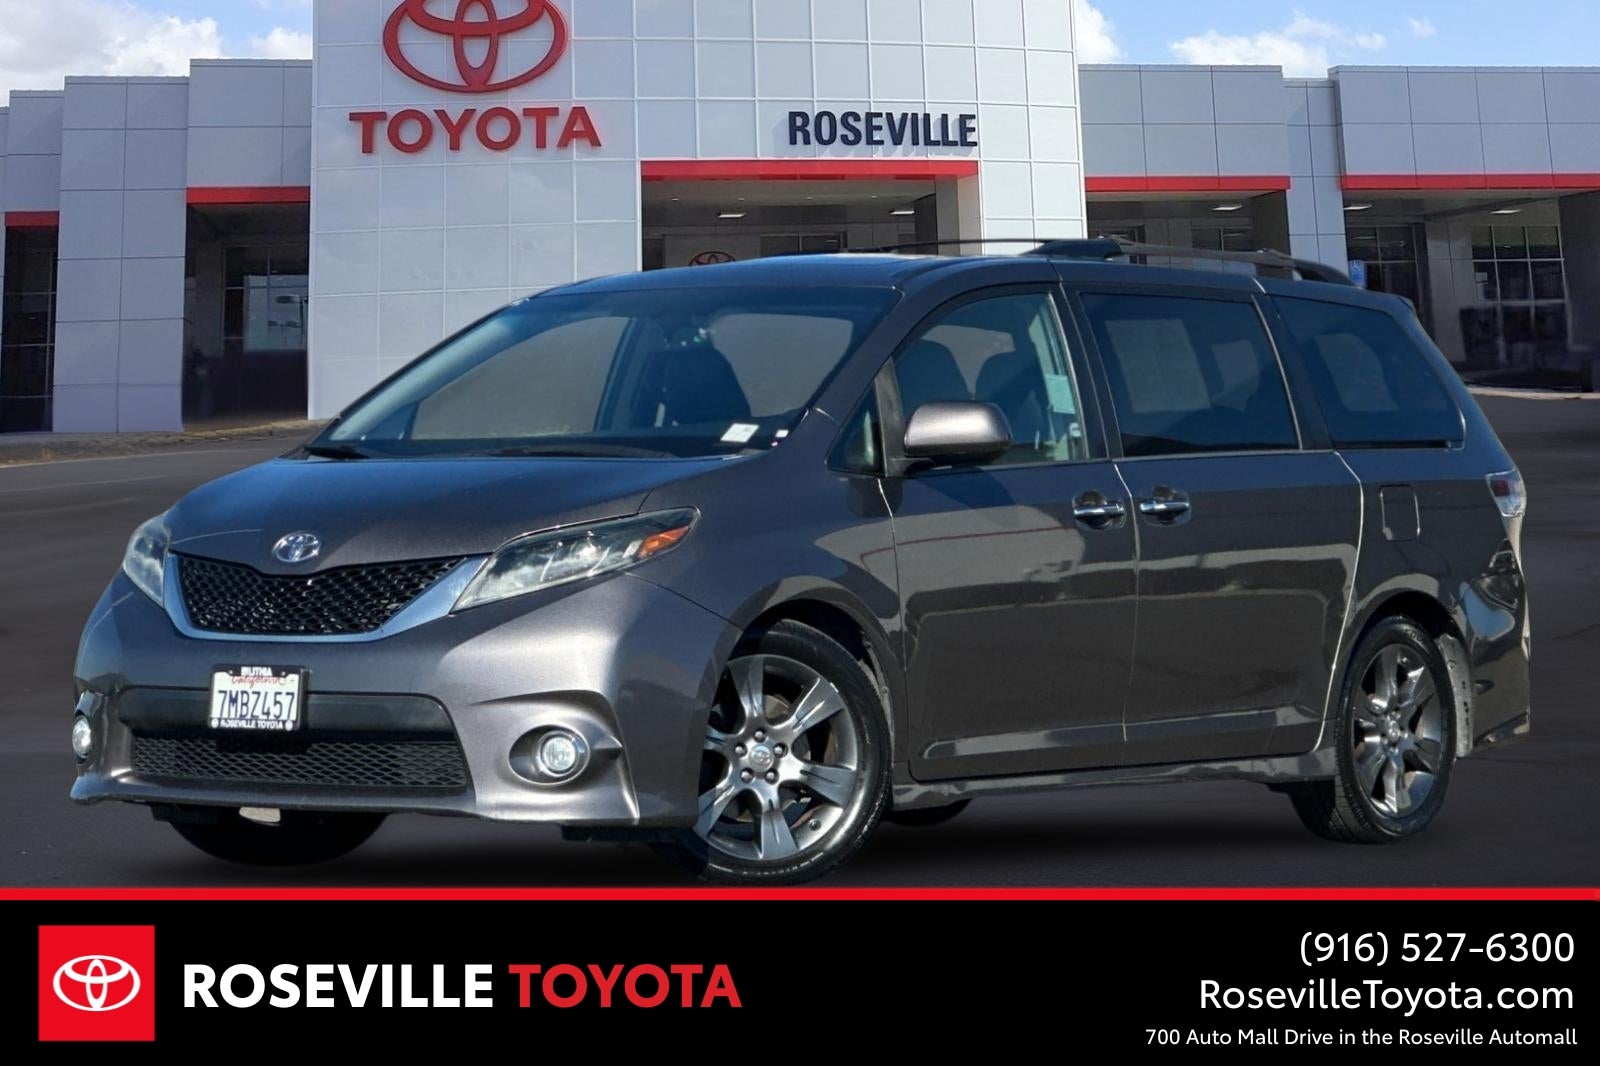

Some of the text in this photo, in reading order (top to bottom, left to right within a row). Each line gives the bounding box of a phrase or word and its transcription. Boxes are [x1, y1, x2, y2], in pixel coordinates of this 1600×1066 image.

[348, 105, 602, 154] TOYOTA
[788, 110, 978, 147] ROSEVILLE
[218, 689, 296, 721] 7MBZ457
[256, 720, 284, 730] TOYOTA
